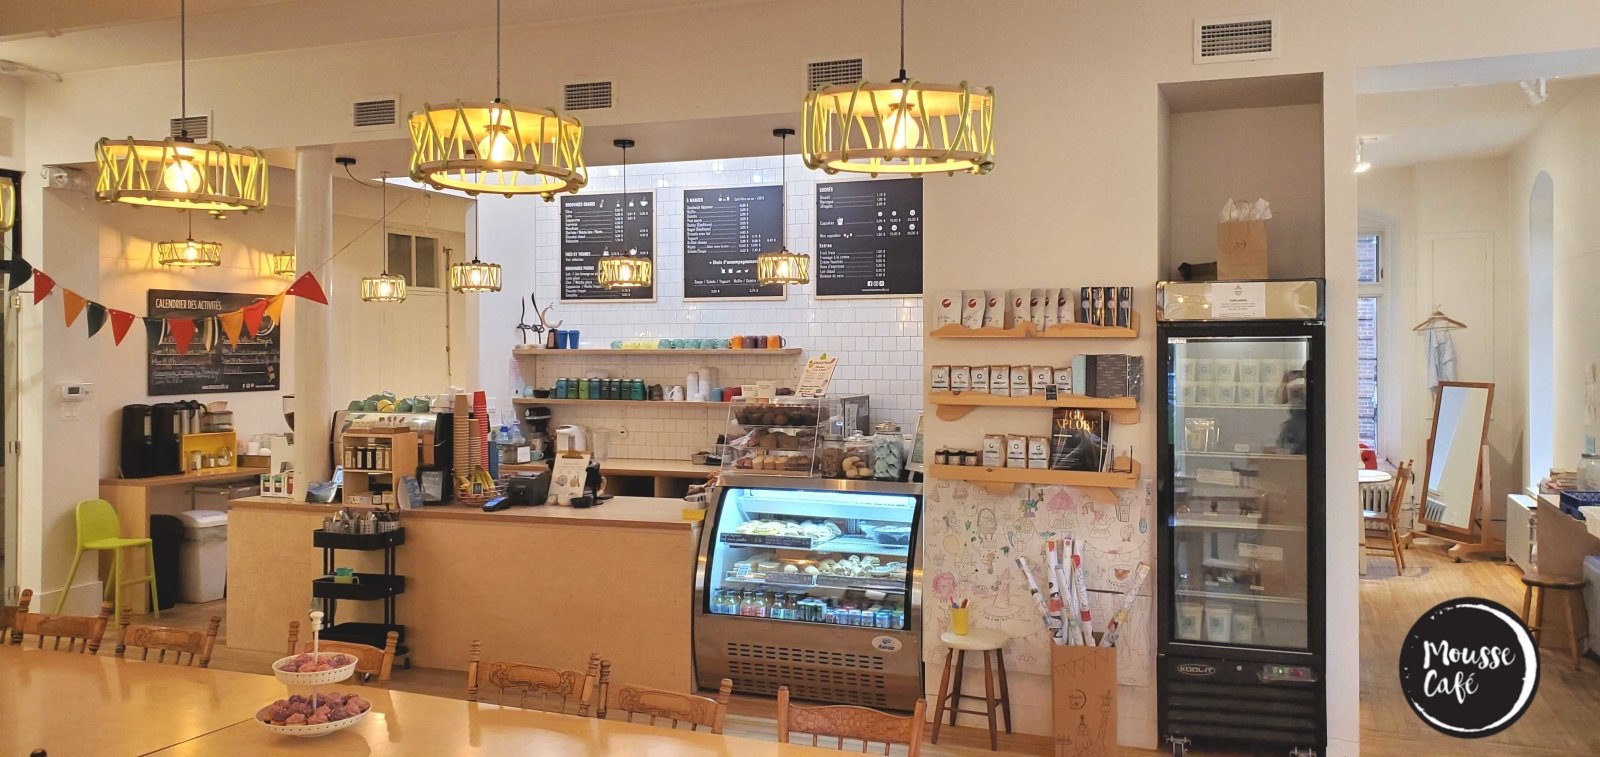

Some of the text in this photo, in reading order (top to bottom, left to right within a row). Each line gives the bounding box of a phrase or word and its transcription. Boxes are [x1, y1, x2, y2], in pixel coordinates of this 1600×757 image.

[155, 298, 222, 310] CALENDRIER DES ACTIVITÉS
